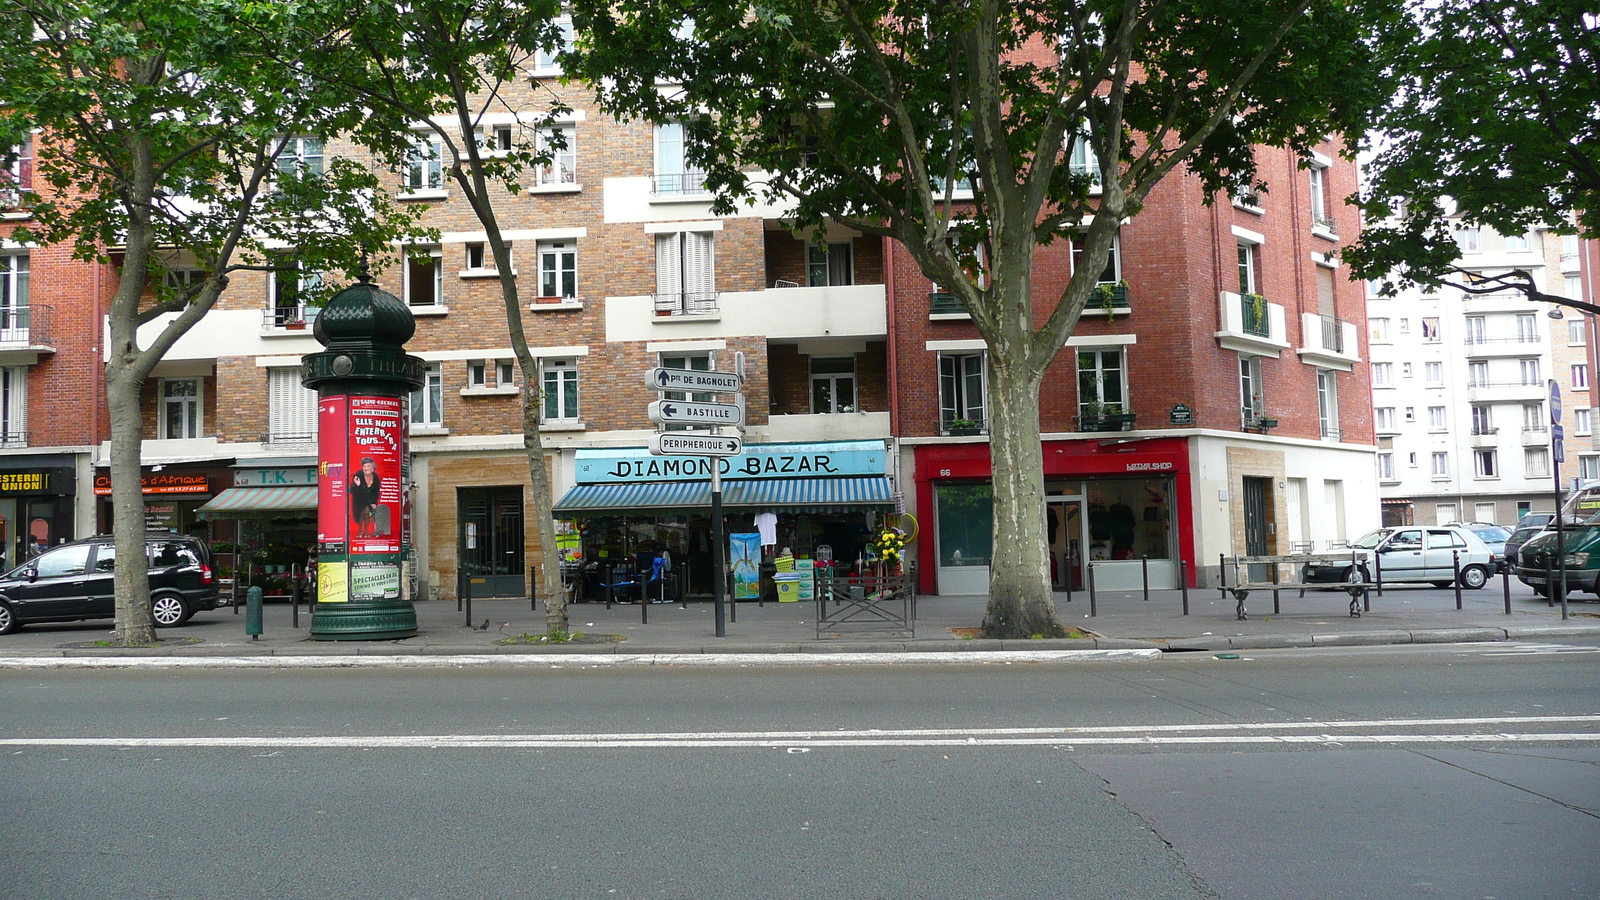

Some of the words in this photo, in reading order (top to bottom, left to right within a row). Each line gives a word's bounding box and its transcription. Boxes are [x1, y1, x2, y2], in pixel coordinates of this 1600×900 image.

[684, 376, 693, 384] DE
[697, 377, 737, 388] BAGNOLET
[687, 408, 729, 418] BASTILLE
[355, 418, 373, 426] ELLE
[375, 419, 397, 428] NOUS
[664, 439, 723, 449] PERIPHERIQUE
[607, 458, 731, 478] DIAMOND
[737, 455, 839, 476] BAZAR
[940, 469, 951, 477] 66
[150, 475, 206, 486] d'Afrique
[1, 482, 40, 491] UNION
[353, 574, 386, 585] SPECTACLES
